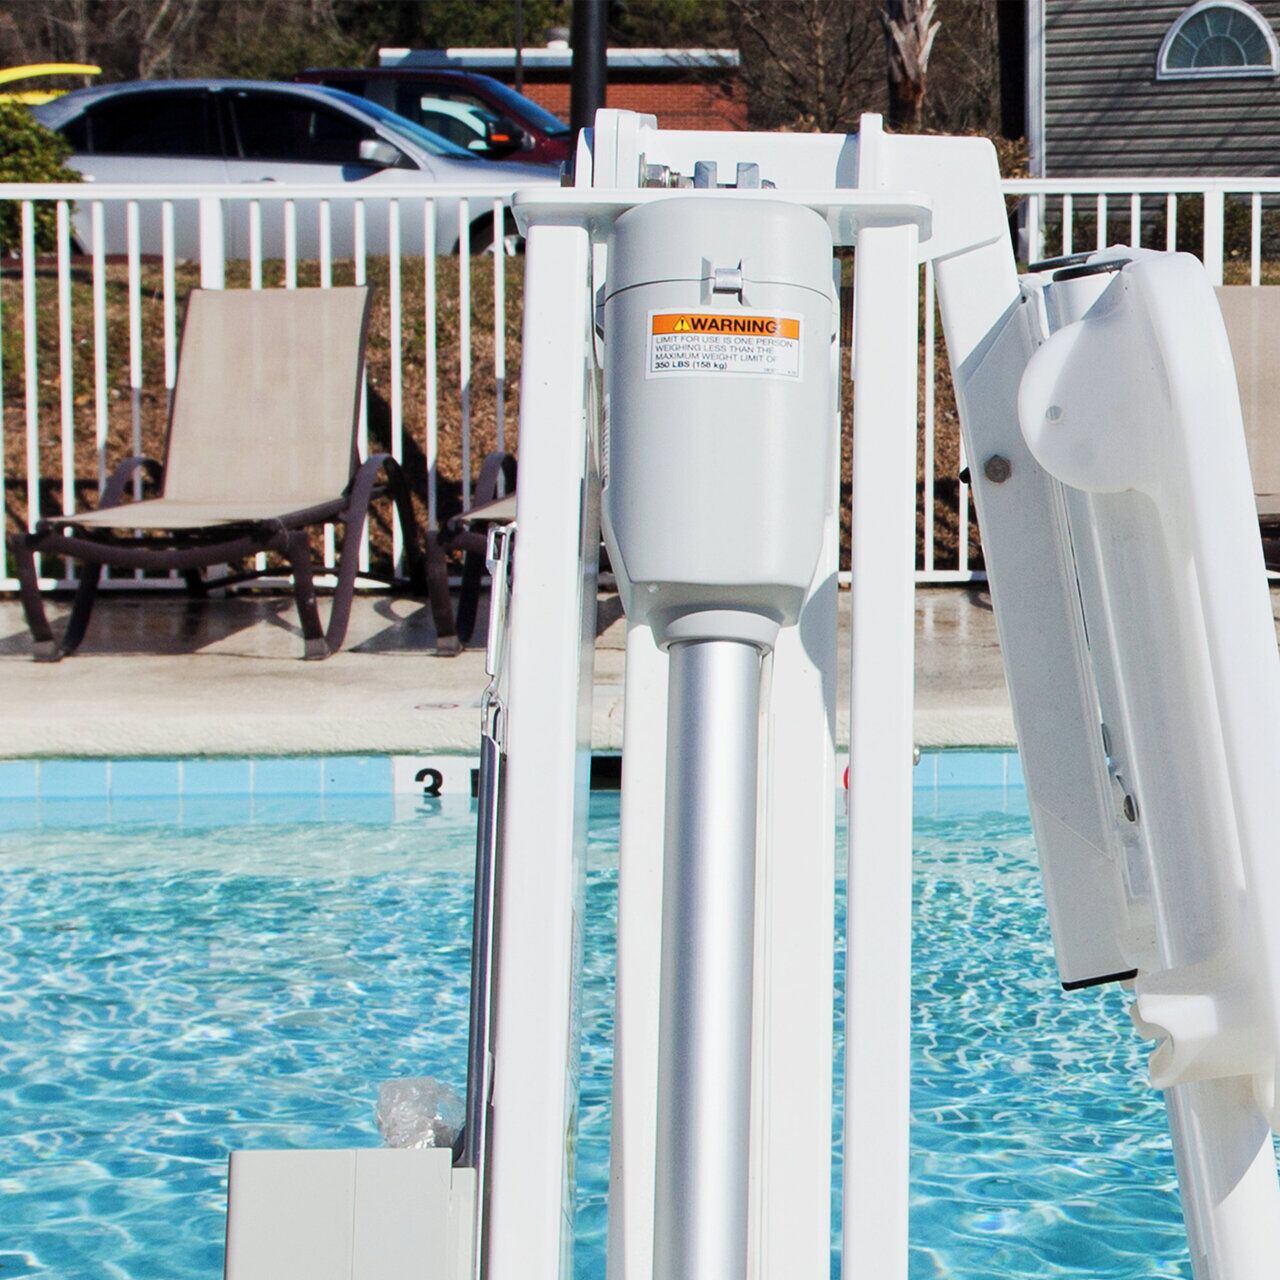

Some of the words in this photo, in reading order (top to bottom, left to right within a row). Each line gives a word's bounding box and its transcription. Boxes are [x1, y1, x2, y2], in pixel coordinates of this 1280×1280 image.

[691, 317, 779, 334] WARNING
[655, 335, 678, 344] LIMIT
[680, 335, 700, 343] FOR
[702, 336, 721, 344] USE
[734, 337, 753, 345] ONE
[756, 338, 793, 348] PERSON
[655, 344, 701, 353] WEIGHING
[703, 345, 727, 353] LESS
[730, 346, 755, 354] THAN
[757, 347, 774, 355] THE
[655, 352, 700, 361] MAXIMUM
[702, 353, 738, 362] WEIGHT
[740, 354, 763, 363] LIMIT
[713, 362, 728, 370] kg)
[414, 768, 444, 797] 3
